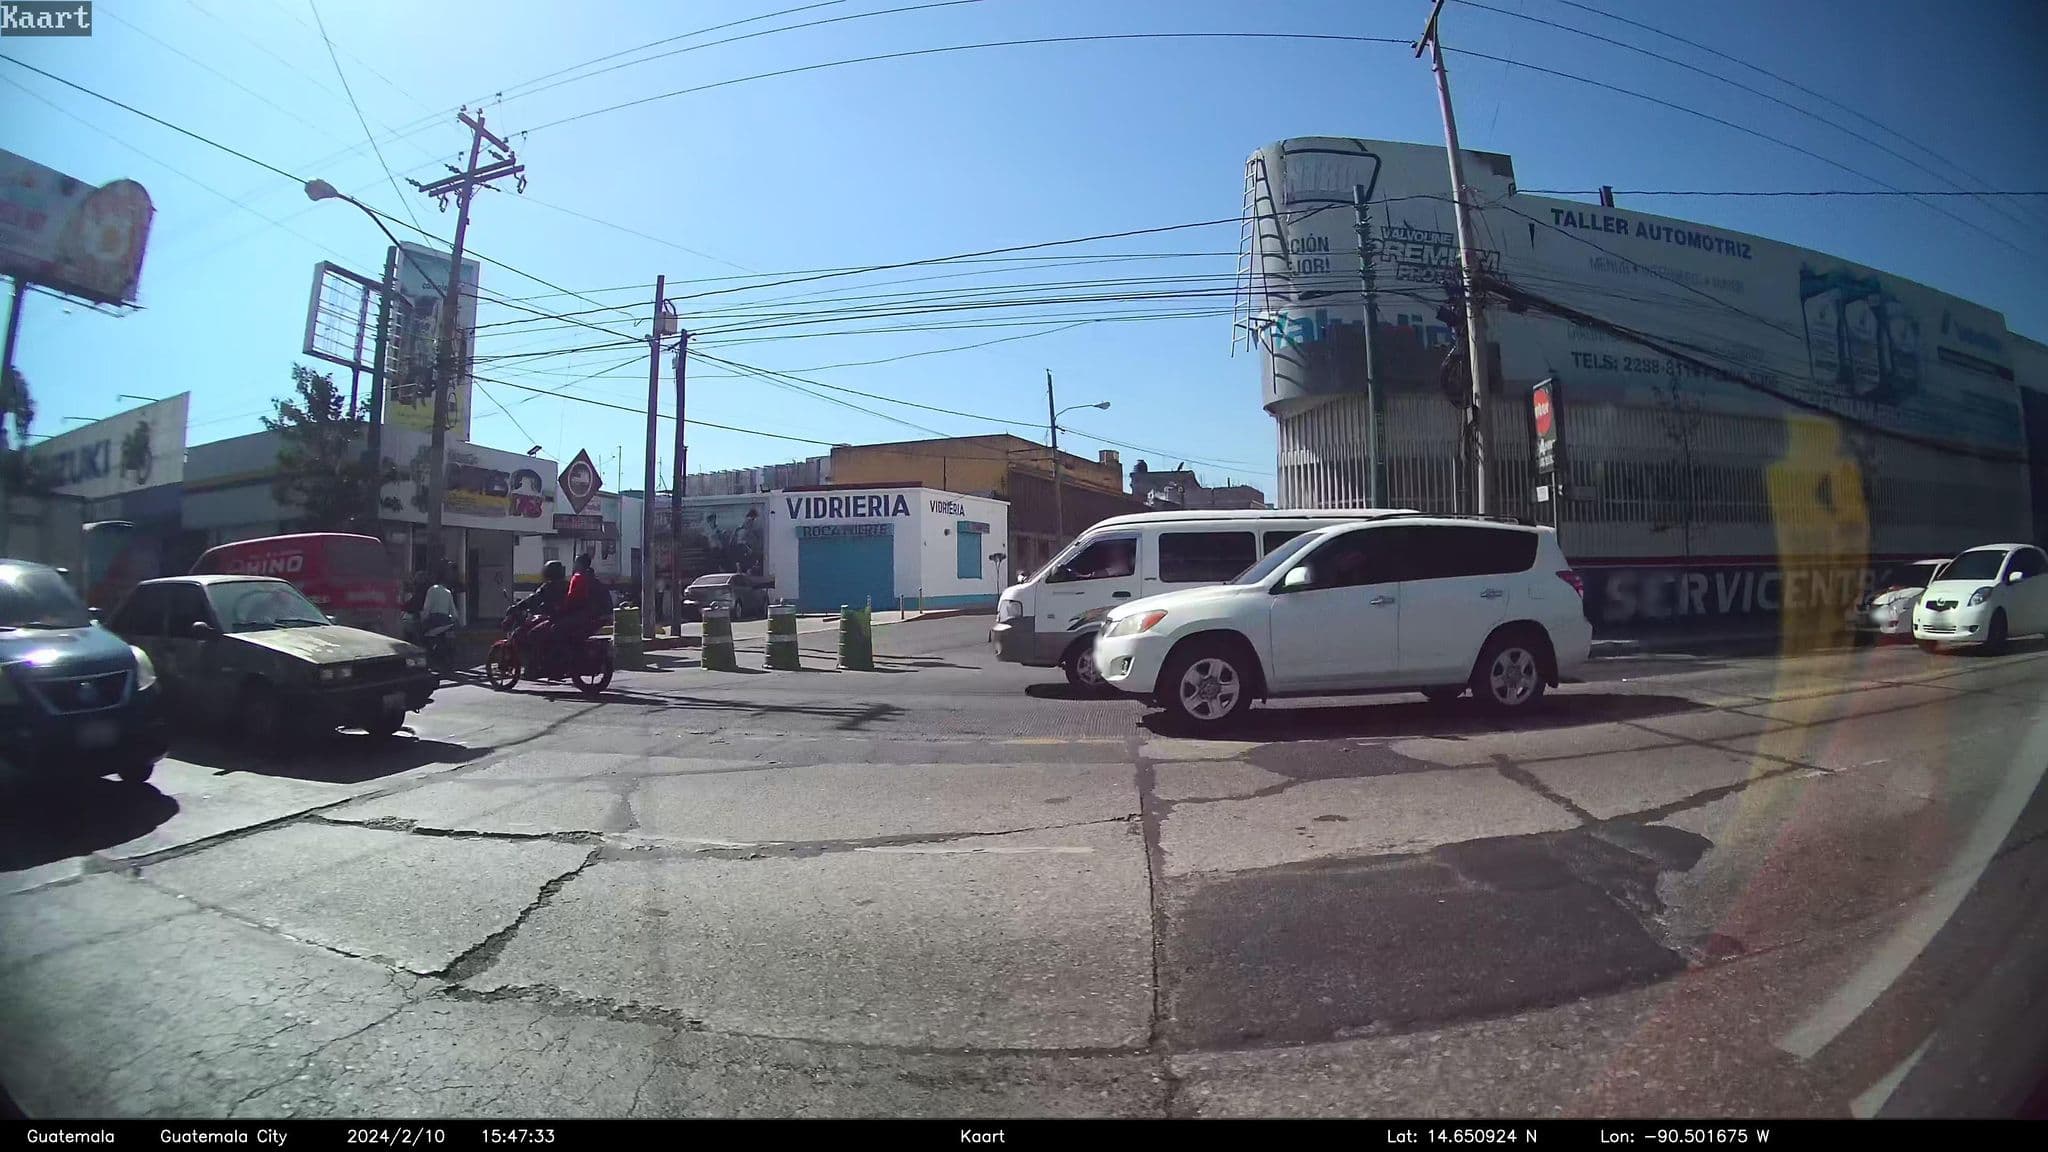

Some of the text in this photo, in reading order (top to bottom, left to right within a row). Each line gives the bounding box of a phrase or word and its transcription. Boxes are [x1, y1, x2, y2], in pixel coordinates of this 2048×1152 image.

[1551, 208, 1629, 235] TALLER
[1381, 226, 1453, 244] VALVOLINE
[1371, 239, 1500, 271] PREMIM
[1571, 352, 1617, 372] TELS:
[786, 494, 910, 519] VIDRIERIA
[929, 500, 965, 517] VIDRIERIA
[1603, 566, 1894, 620] SERVICENTR
